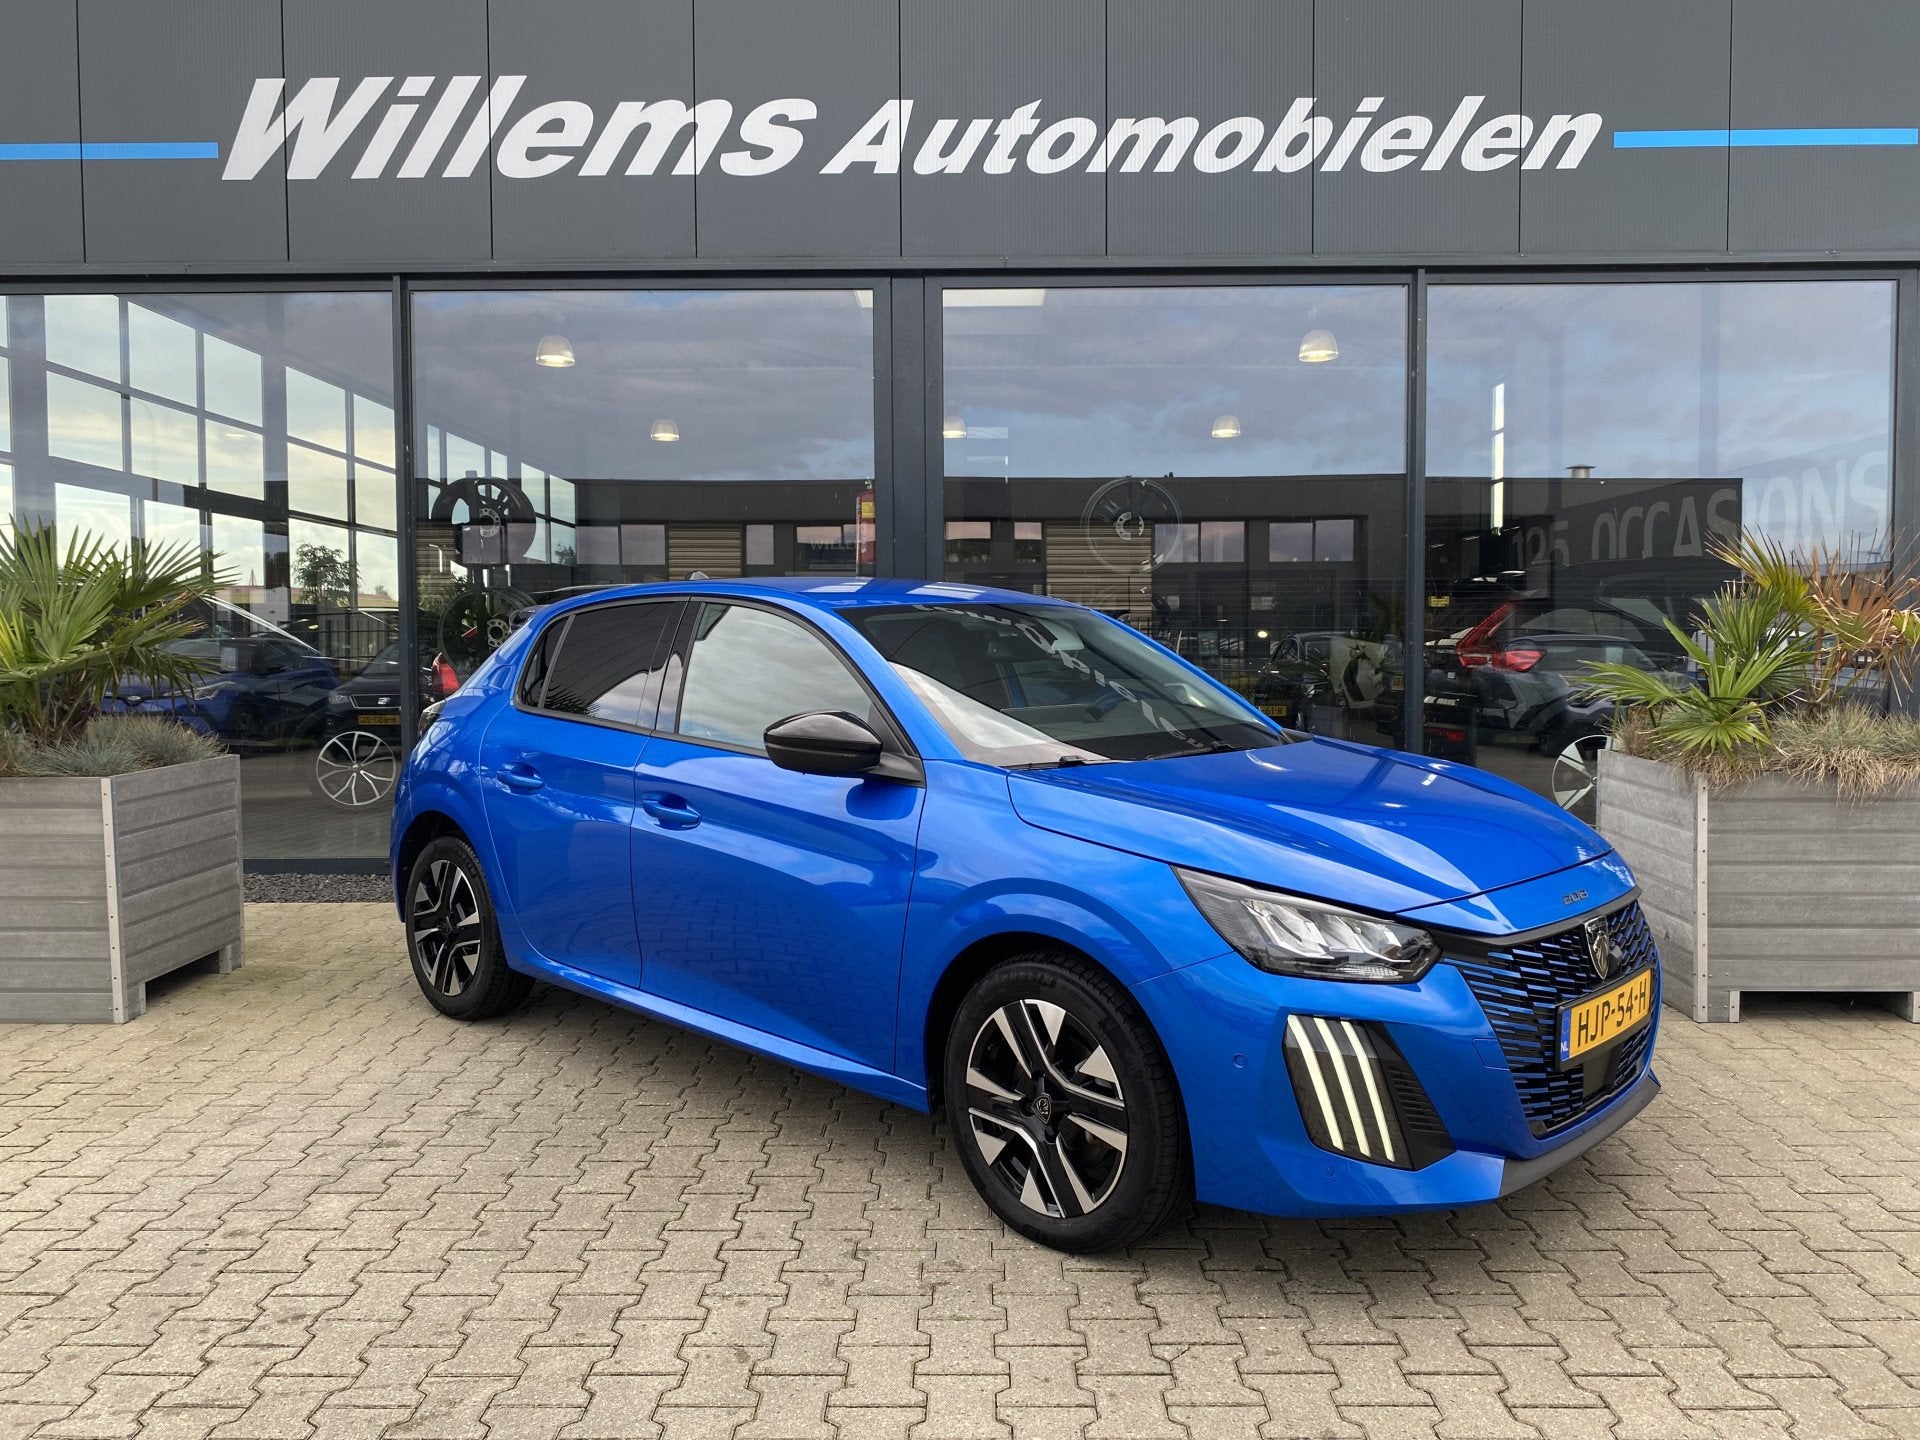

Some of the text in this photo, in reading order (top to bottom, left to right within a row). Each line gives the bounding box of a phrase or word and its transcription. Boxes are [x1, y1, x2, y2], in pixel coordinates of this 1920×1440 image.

[221, 75, 1603, 181] Willems Automobielen
[1578, 978, 1647, 1048] HJP-54-H
